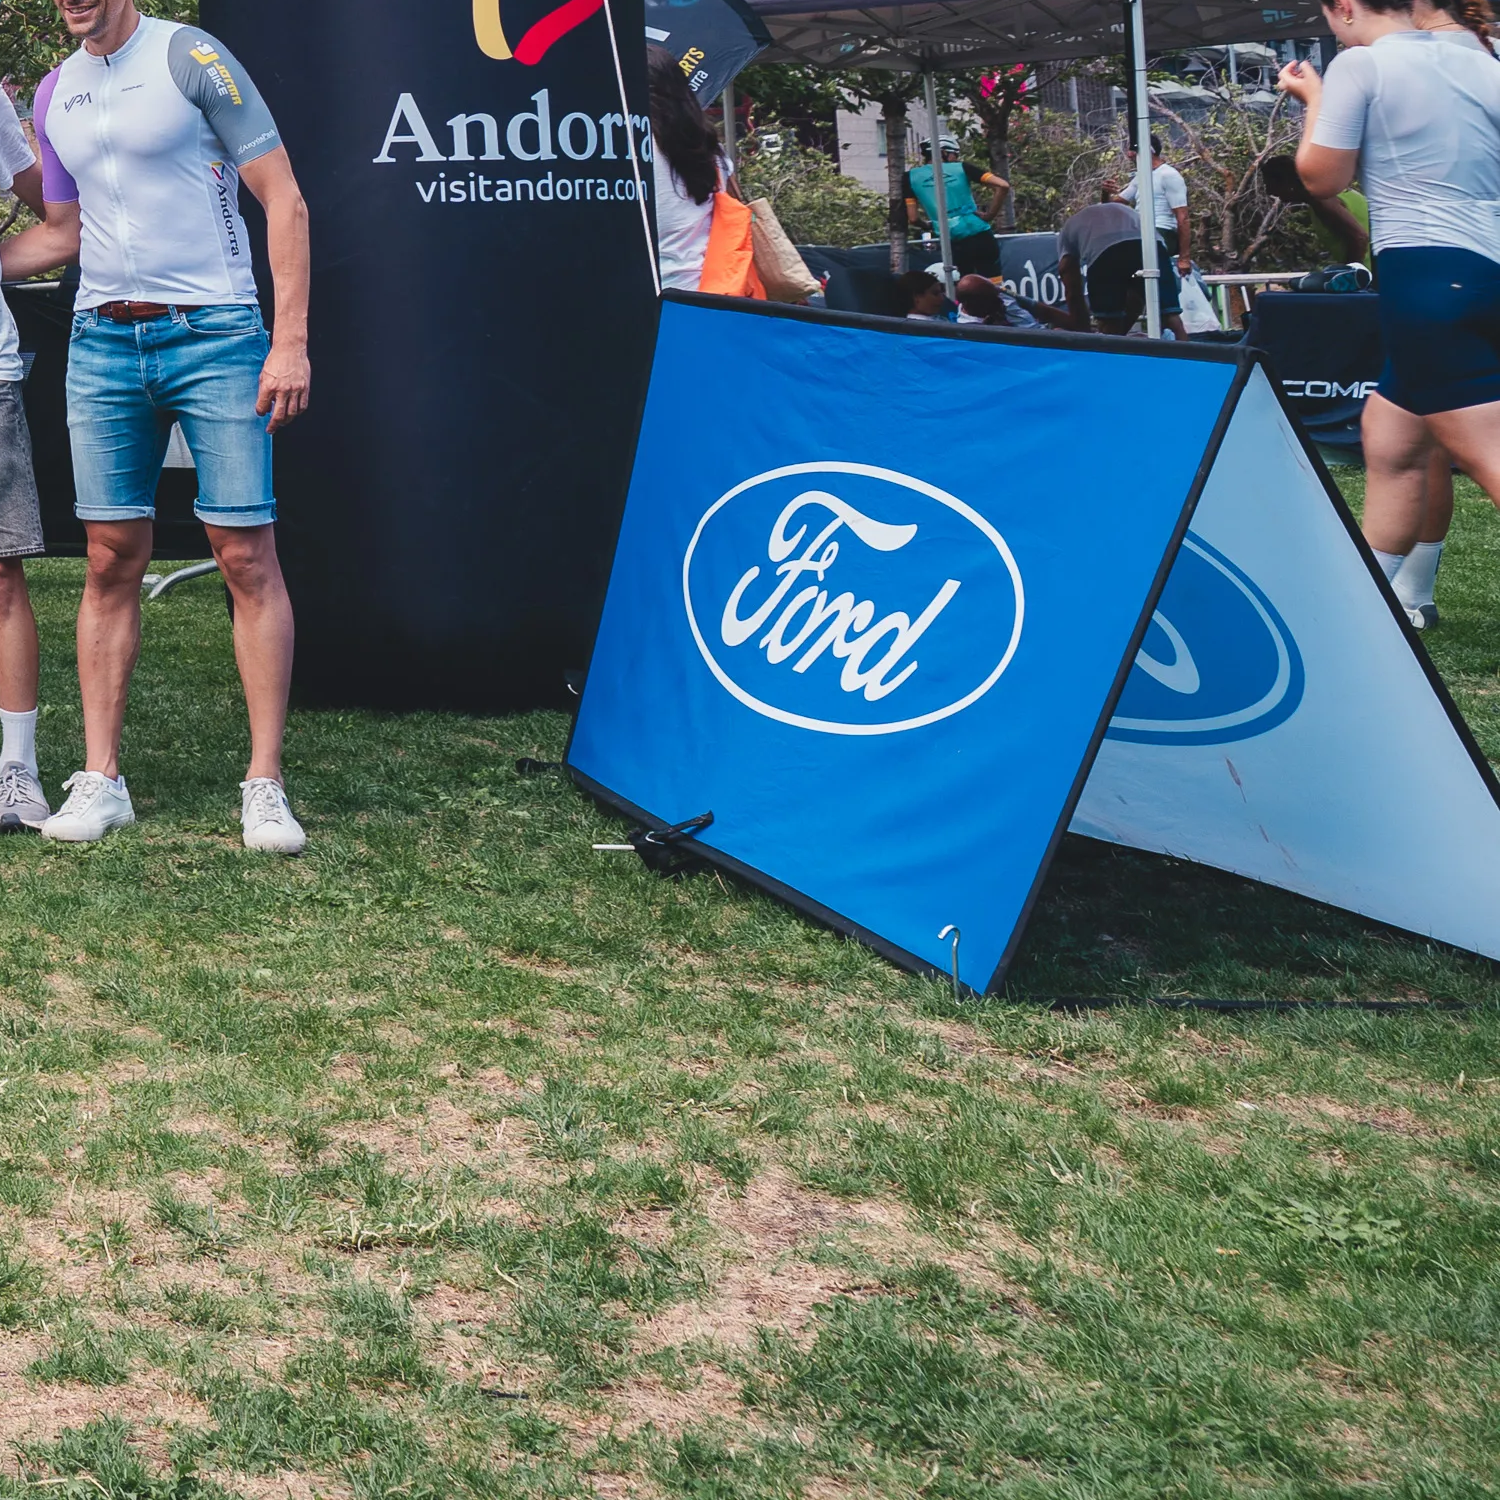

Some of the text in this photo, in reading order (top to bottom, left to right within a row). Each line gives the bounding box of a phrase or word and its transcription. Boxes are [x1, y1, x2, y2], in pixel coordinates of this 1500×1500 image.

[206, 66, 229, 97] BIKE
[372, 88, 653, 164] Andorra
[216, 183, 240, 257] Andorra
[416, 172, 649, 204] visitandorra.com
[722, 490, 961, 702] Ford
